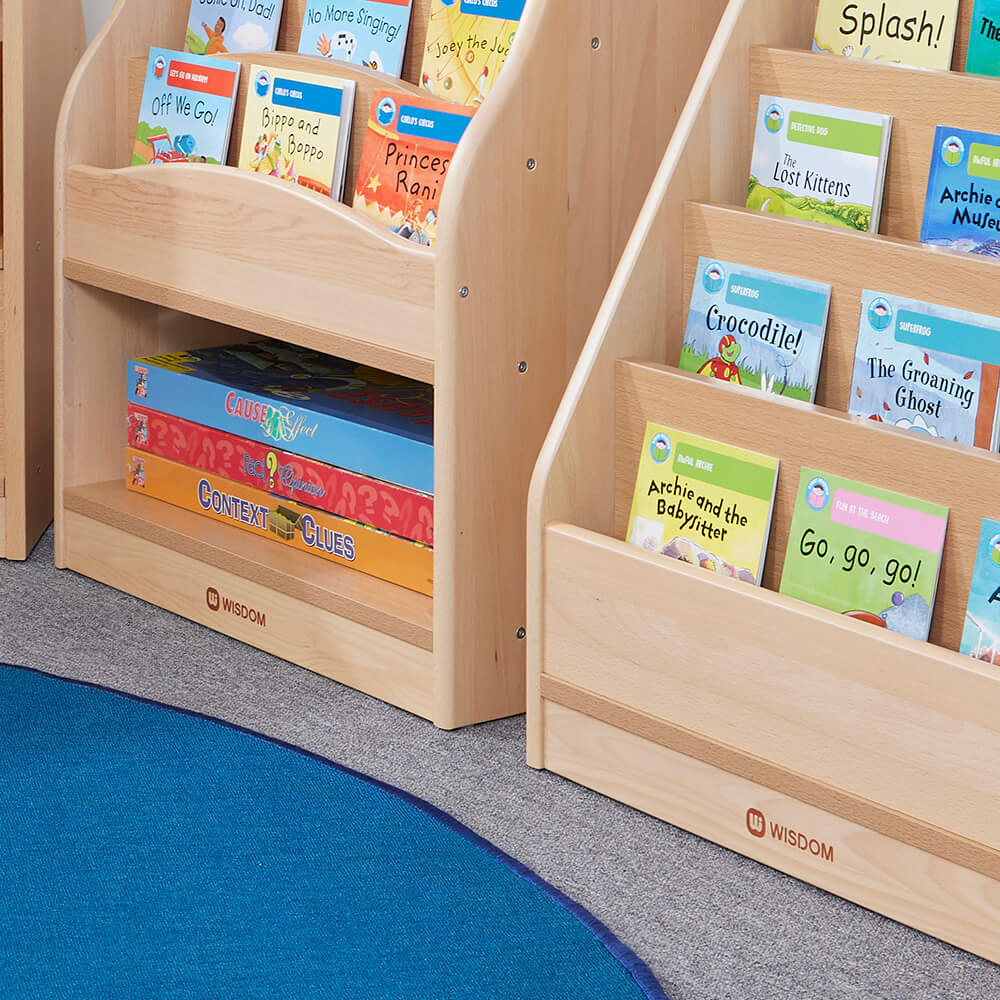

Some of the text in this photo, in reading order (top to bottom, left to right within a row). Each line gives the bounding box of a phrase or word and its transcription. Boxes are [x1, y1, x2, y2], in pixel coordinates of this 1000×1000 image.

[307, 4, 402, 43] No More Singing!
[839, 2, 945, 49] Splash!
[436, 41, 463, 58] Joey
[467, 34, 488, 50] the
[152, 93, 219, 127] Off We Go!
[262, 107, 320, 136] Bippo and
[288, 133, 324, 162] Boppo
[783, 153, 797, 168] The
[395, 170, 439, 200] Rani
[773, 161, 852, 198] Lost Kittens
[940, 182, 993, 206] Archie
[706, 304, 803, 355] Crocodile!
[899, 320, 932, 337] SUPERFROG
[867, 357, 975, 410] The Groaning
[225, 391, 267, 424] CAUSE
[278, 405, 319, 443] Effect
[895, 385, 942, 419] Ghost
[278, 463, 326, 498] Opinion
[647, 475, 748, 527] Archie and the
[197, 479, 356, 561] CONTEXT CLUES
[656, 498, 728, 541] Babysitter
[800, 528, 922, 588] Go, go, go!
[222, 597, 266, 627] WISDOM
[770, 821, 834, 863] WISDOM
